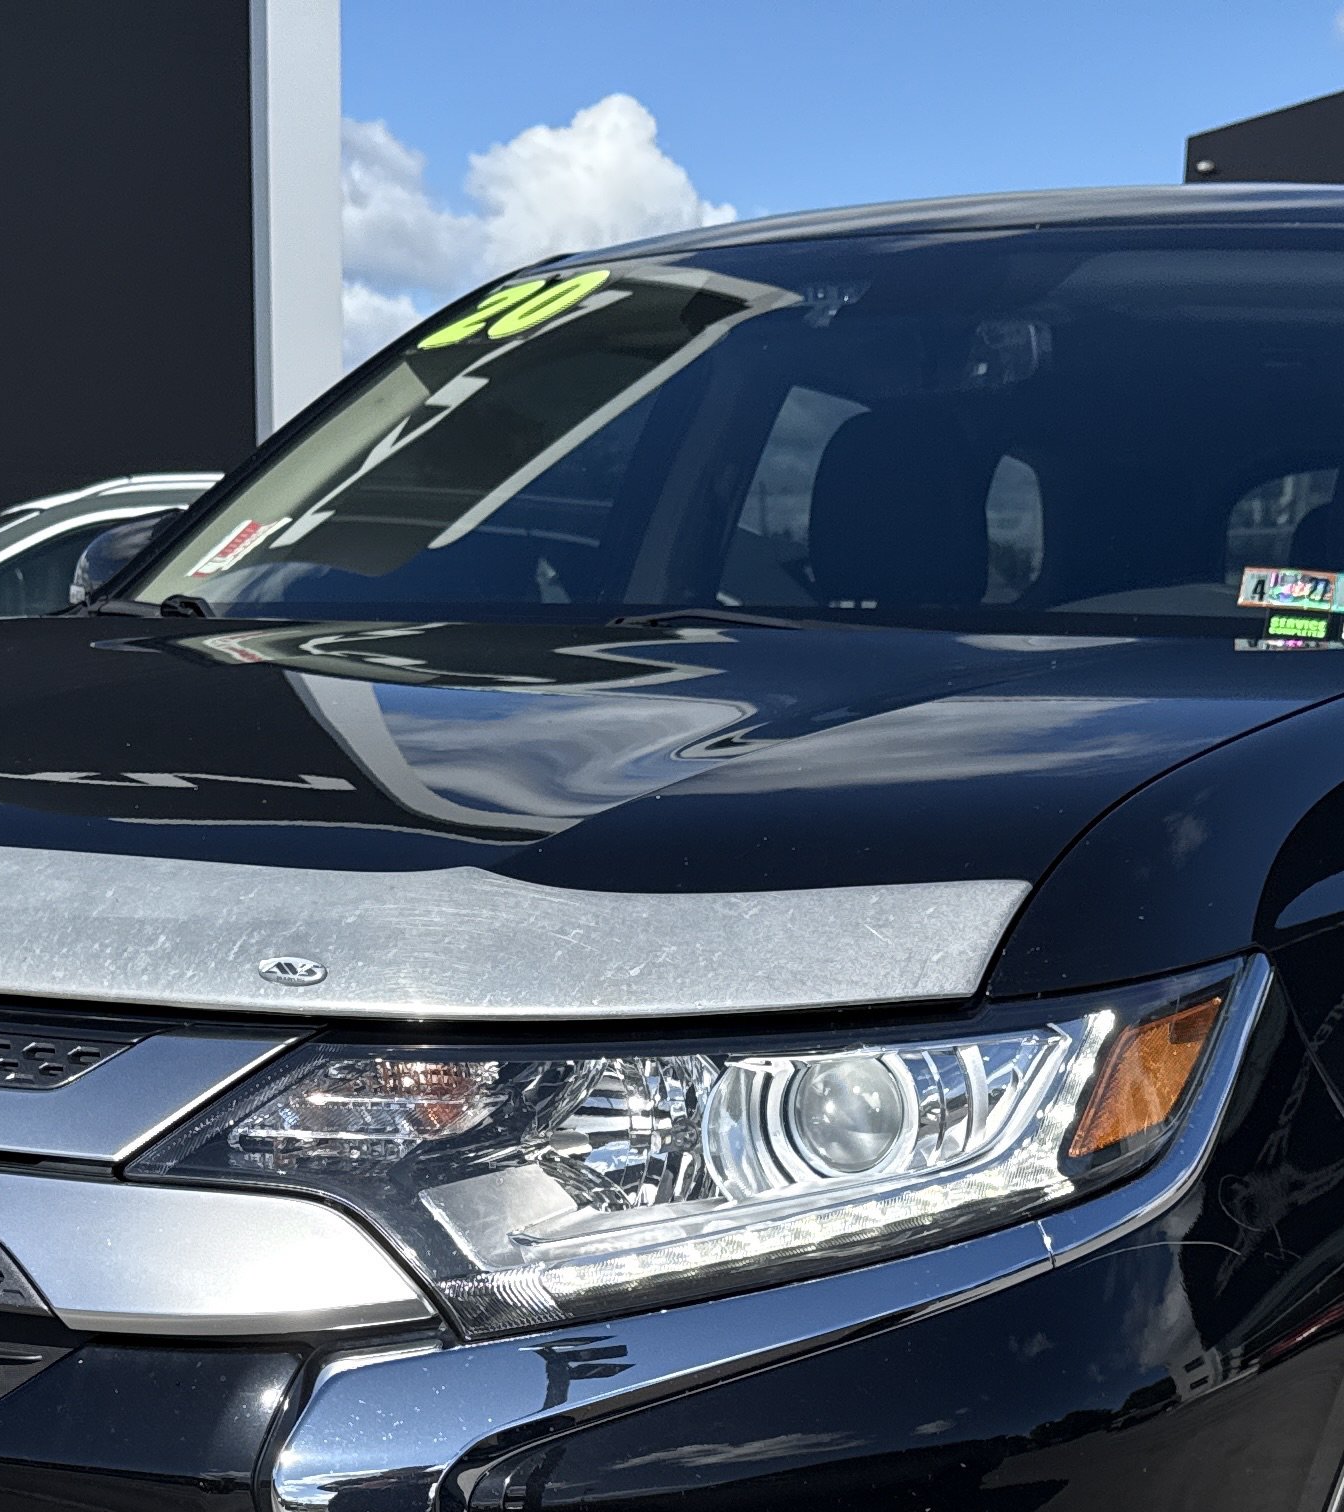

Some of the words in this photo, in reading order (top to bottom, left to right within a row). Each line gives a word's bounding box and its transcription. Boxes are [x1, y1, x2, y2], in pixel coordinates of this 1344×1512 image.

[416, 269, 611, 350] 20
[1251, 578, 1266, 602] 4
[1270, 616, 1327, 632] SERVICE
